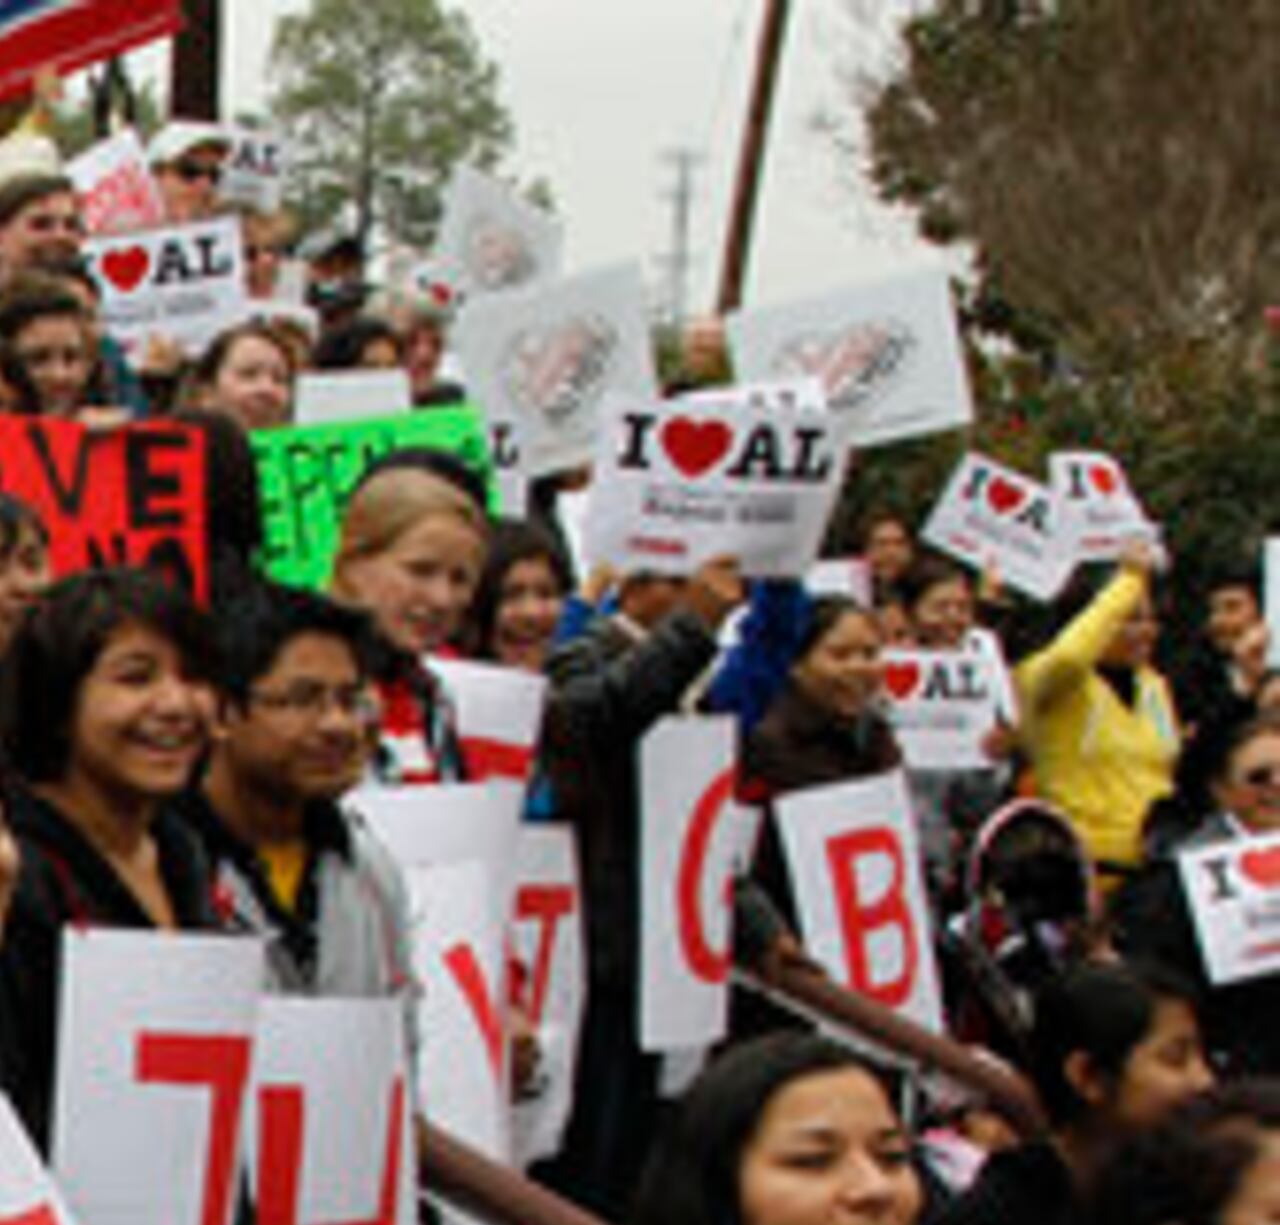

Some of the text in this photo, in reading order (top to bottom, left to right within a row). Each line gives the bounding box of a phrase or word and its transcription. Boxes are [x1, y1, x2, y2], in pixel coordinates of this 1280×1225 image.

[152, 236, 233, 286] AL
[619, 414, 833, 483] I AL
[922, 664, 987, 701] AL
[826, 827, 918, 1010] B
